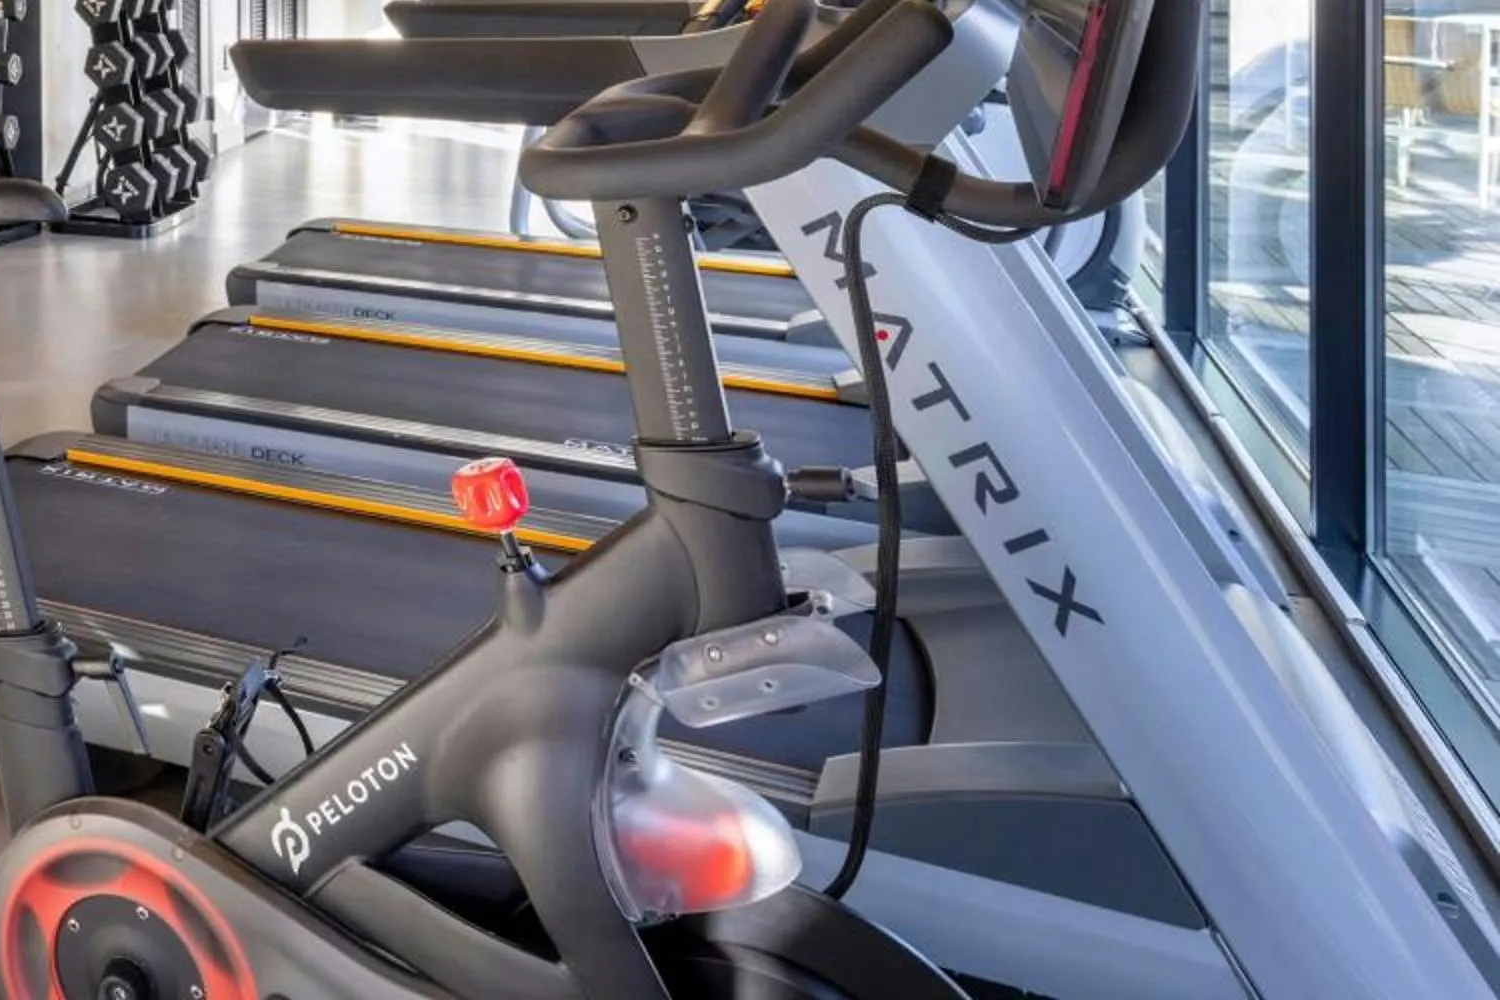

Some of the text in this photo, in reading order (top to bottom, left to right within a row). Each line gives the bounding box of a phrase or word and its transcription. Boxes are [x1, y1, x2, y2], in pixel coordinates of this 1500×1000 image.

[250, 446, 306, 466] DECK
[801, 210, 1105, 639] MATRIX
[305, 742, 418, 836] PELOTON
